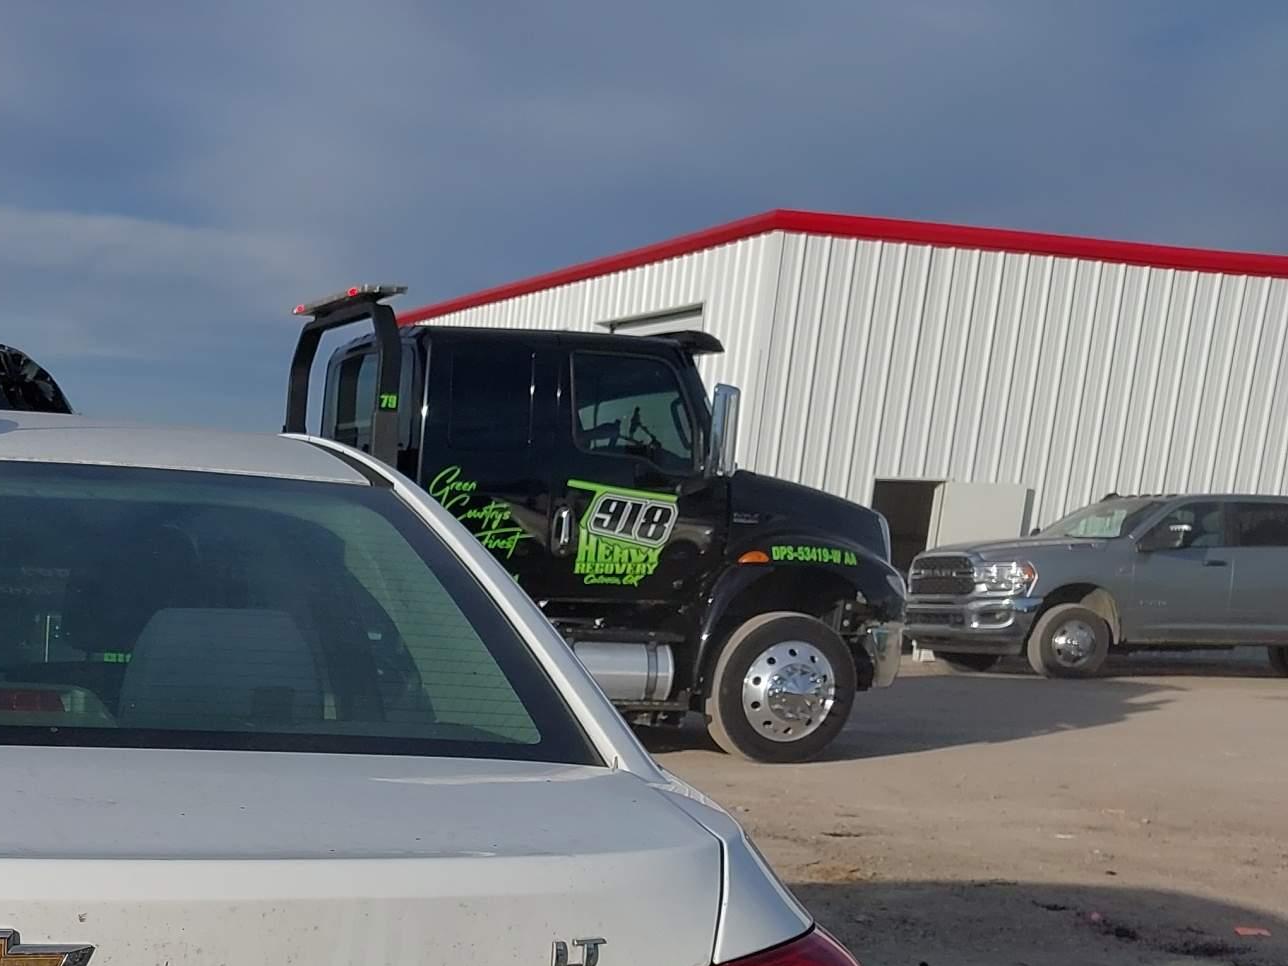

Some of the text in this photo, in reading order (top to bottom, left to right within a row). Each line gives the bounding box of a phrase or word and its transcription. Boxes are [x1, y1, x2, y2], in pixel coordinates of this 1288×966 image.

[429, 465, 477, 506] Green
[589, 495, 676, 546] 918
[577, 529, 664, 562] HEAVY
[574, 561, 658, 575] RECOVERY
